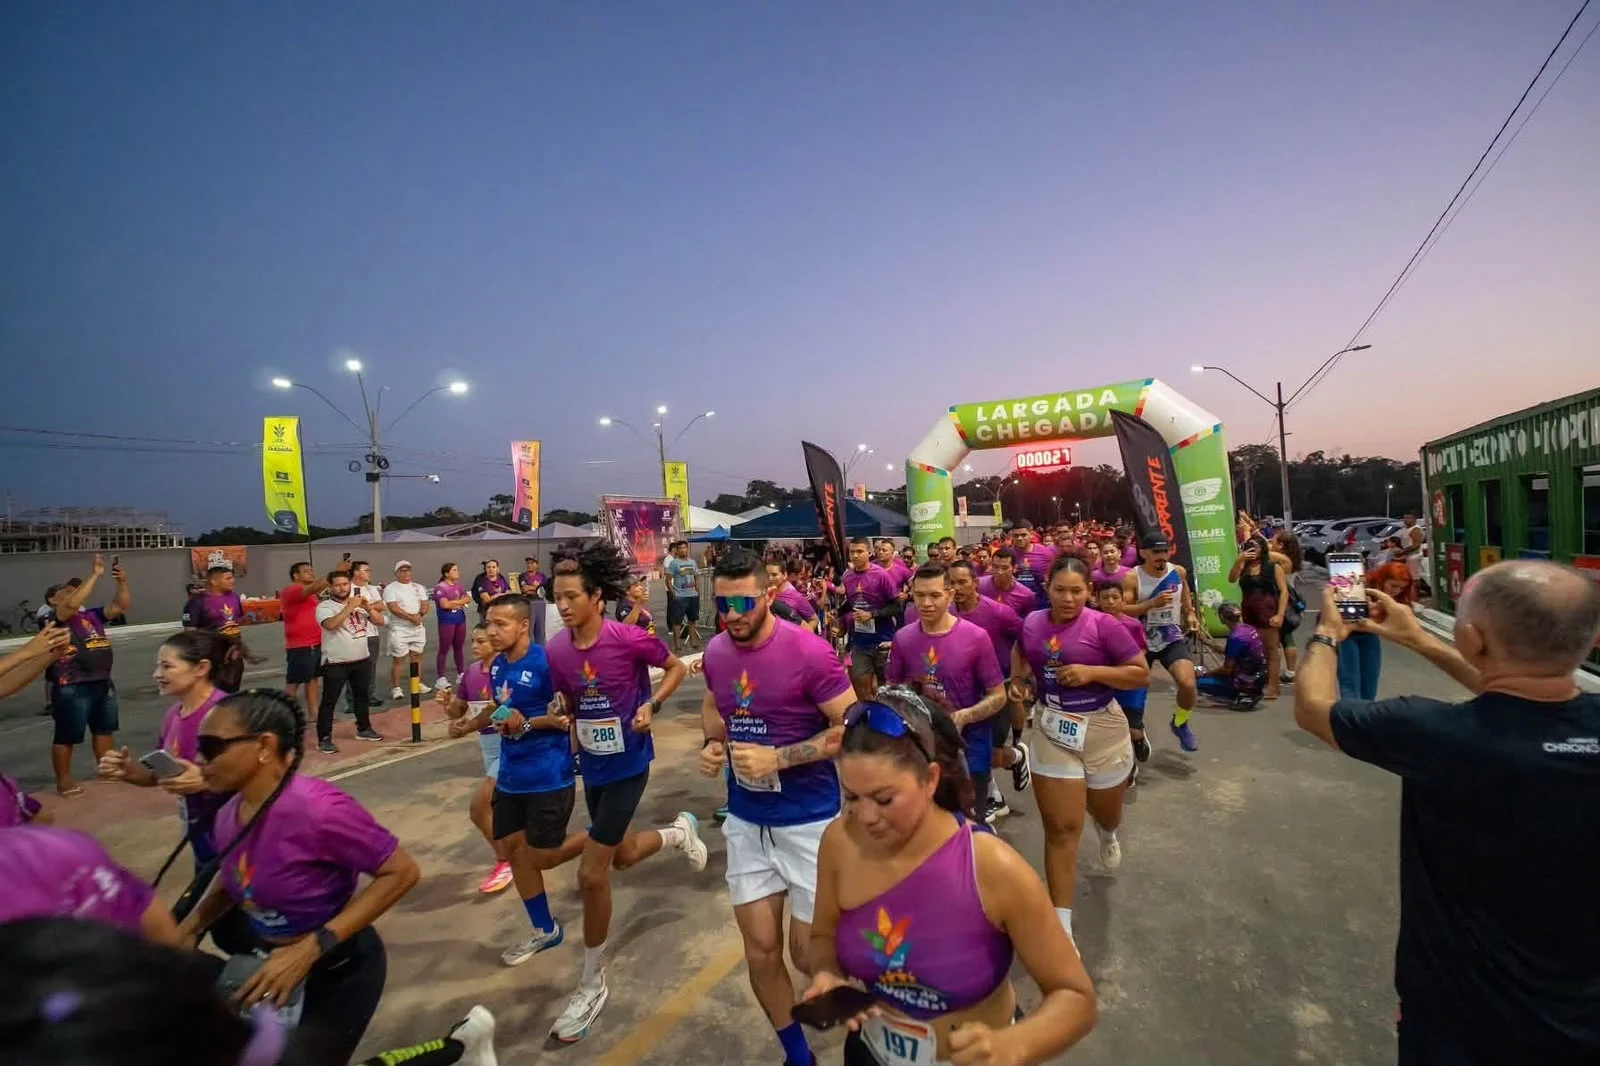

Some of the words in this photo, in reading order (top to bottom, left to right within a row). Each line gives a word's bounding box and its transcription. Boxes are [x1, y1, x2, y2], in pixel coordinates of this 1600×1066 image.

[976, 389, 1118, 421] LARGADA
[1018, 449, 1070, 468] 000027
[592, 726, 616, 743] 288
[1058, 719, 1079, 737] 196
[882, 1025, 919, 1063] 197
